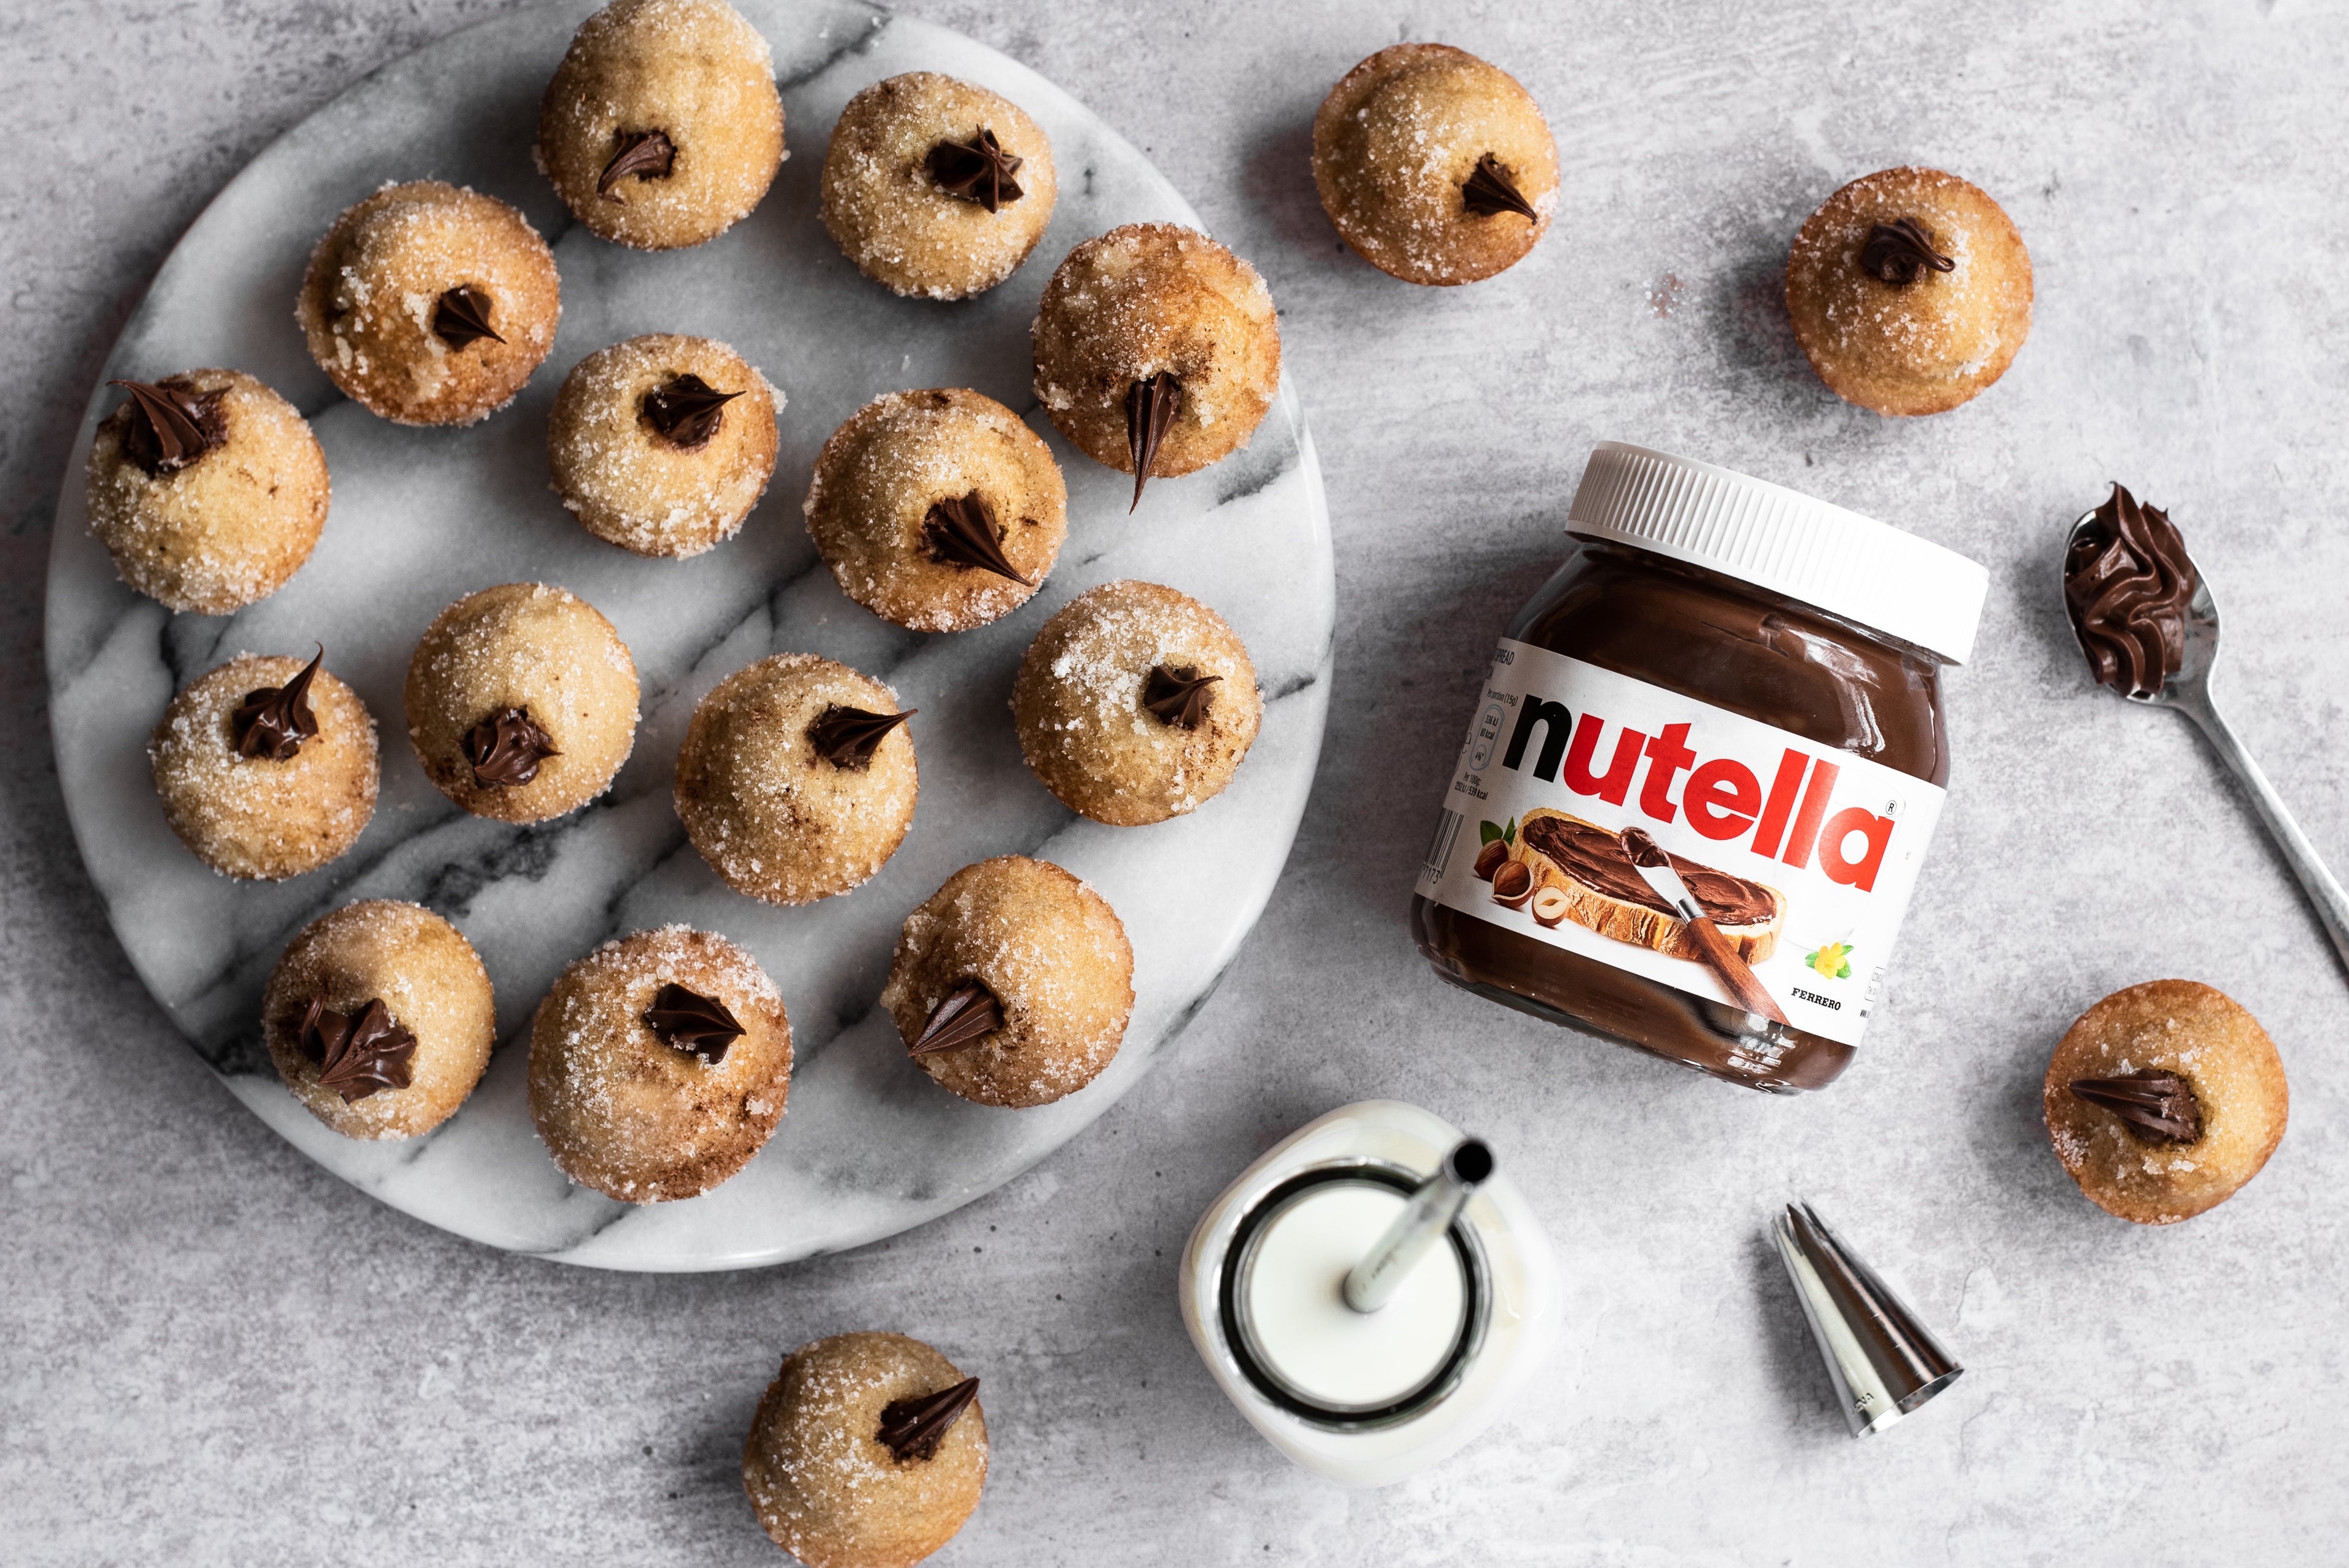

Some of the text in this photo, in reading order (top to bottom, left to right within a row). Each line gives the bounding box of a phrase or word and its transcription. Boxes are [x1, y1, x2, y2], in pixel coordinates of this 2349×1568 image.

[1504, 693, 1518, 707] (15g)
[1485, 715, 1494, 725] 336
[1485, 729, 1495, 740] kcal
[1469, 774, 1482, 787] 100g:
[1468, 786, 1478, 796] 539
[1476, 789, 1488, 800] kcal
[1502, 694, 1894, 893] nutella
[1791, 987, 1841, 1011] FERRERO
